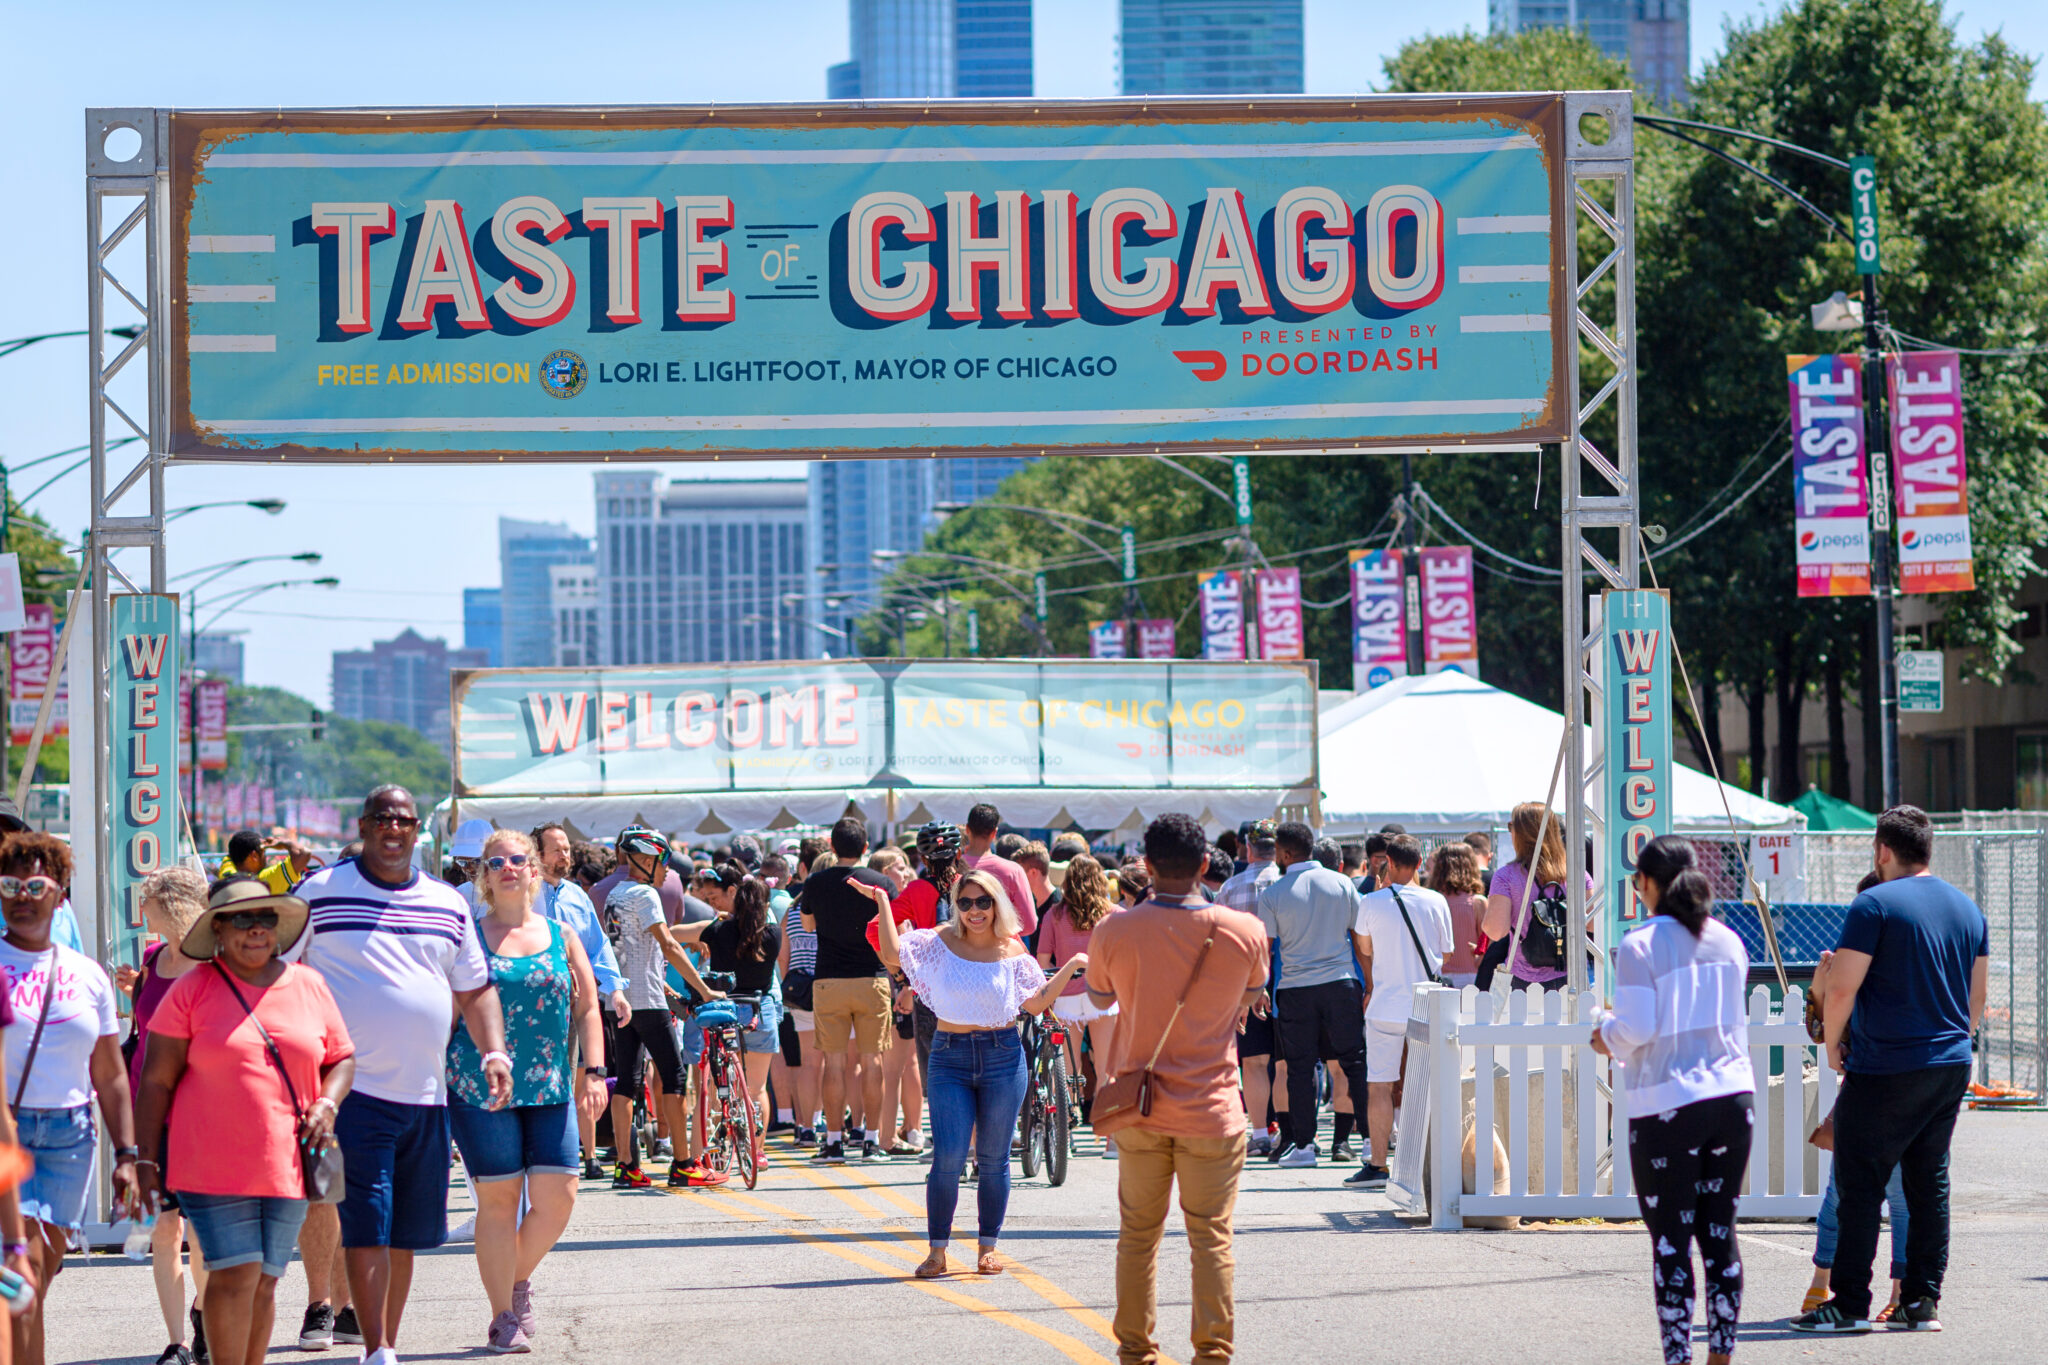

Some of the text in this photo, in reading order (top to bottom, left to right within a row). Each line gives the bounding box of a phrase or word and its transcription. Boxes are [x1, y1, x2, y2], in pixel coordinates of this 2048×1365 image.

[1853, 167, 1877, 262] C130
[293, 185, 1445, 342] TASTE OF CHICAGO
[1242, 324, 1438, 344] PRESENTED BY
[318, 362, 530, 386] FREE ADMISSION
[600, 356, 1117, 383] LORI E. LIGHTFOOT, MAYOR OF CHICAGO
[1242, 347, 1438, 376] DOORDASH
[1798, 368, 1860, 516] TASTE
[1896, 366, 1960, 515] TASTE
[1874, 456, 1888, 527] C130
[1822, 533, 1865, 549] pepsi
[1924, 530, 1966, 547] pepsi
[1800, 565, 1818, 578] CITY
[1820, 565, 1831, 578] OF
[1903, 564, 1921, 577] CITY
[1923, 563, 1934, 576] OF
[1205, 579, 1240, 660] TASTE
[1261, 577, 1298, 660] TASTE
[1356, 558, 1401, 662] TASTE
[1426, 556, 1472, 660] TASTE
[519, 684, 860, 758] WELCOME
[901, 698, 1008, 729] TASTE
[1018, 699, 1068, 729] OF
[1078, 699, 1246, 729] CHICAGO
[1149, 744, 1245, 758] DOORDASH
[1612, 629, 1660, 936] WELCO
[1759, 836, 1791, 848] GATE
[1768, 851, 1779, 875] 1
[5, 965, 82, 989] Smle
[14, 985, 81, 1012] Mre
